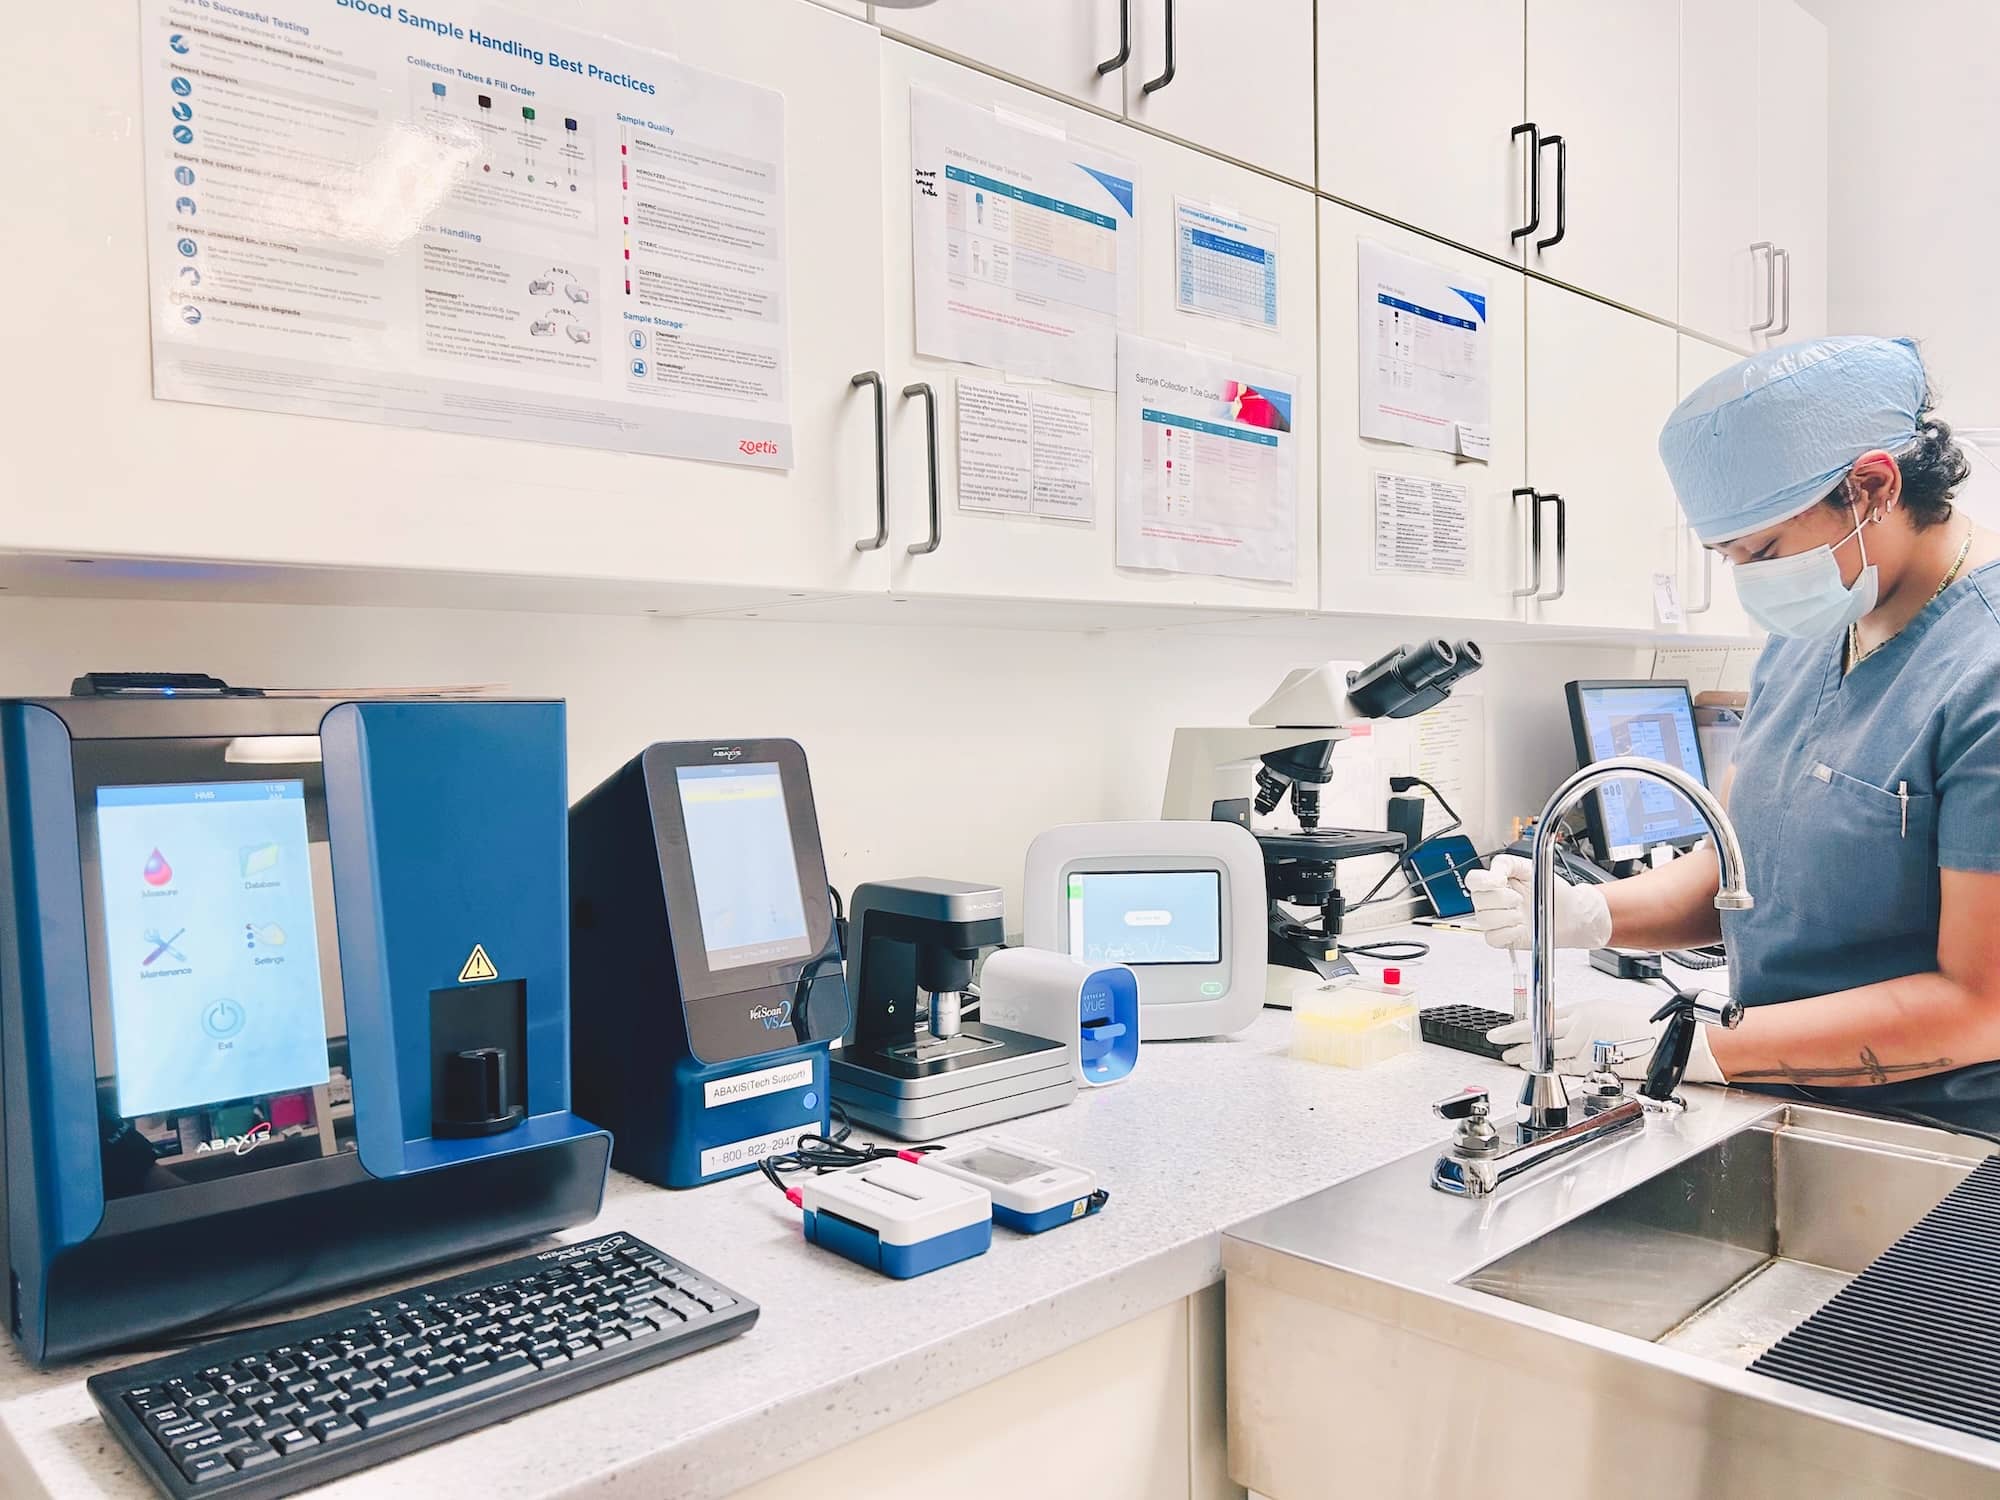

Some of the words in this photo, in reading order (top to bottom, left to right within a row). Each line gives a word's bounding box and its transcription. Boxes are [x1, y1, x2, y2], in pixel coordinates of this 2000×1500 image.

[213, 0, 269, 24] Successful
[272, 17, 309, 35] Testing
[398, 8, 464, 39] Sample
[469, 29, 543, 65] Handling
[549, 52, 583, 75] Best
[588, 64, 656, 95] Practices
[170, 62, 199, 76] Prevent
[407, 55, 455, 75] Collection
[457, 69, 484, 83] Tubes
[486, 77, 492, 85] &
[494, 79, 508, 90] Fill
[510, 84, 535, 97] Order
[616, 112, 646, 128] Sample
[647, 121, 675, 135] Quality
[439, 225, 481, 242] Handling
[638, 240, 658, 249] ICTERIC
[623, 311, 652, 324] Sample
[653, 316, 683, 329] Storage
[1135, 373, 1159, 389] Sample
[1160, 379, 1188, 393] Collection
[1189, 385, 1203, 397] Tube
[1203, 388, 1220, 401] Guide
[738, 440, 778, 455] zoetis
[712, 750, 742, 760] ABAXIS
[245, 881, 281, 890] Database
[254, 956, 285, 966] Settings
[140, 967, 193, 979] Maintenance
[1083, 999, 1106, 1012] VUE
[218, 1042, 233, 1050] Exit
[196, 1128, 272, 1155] ABAXIS
